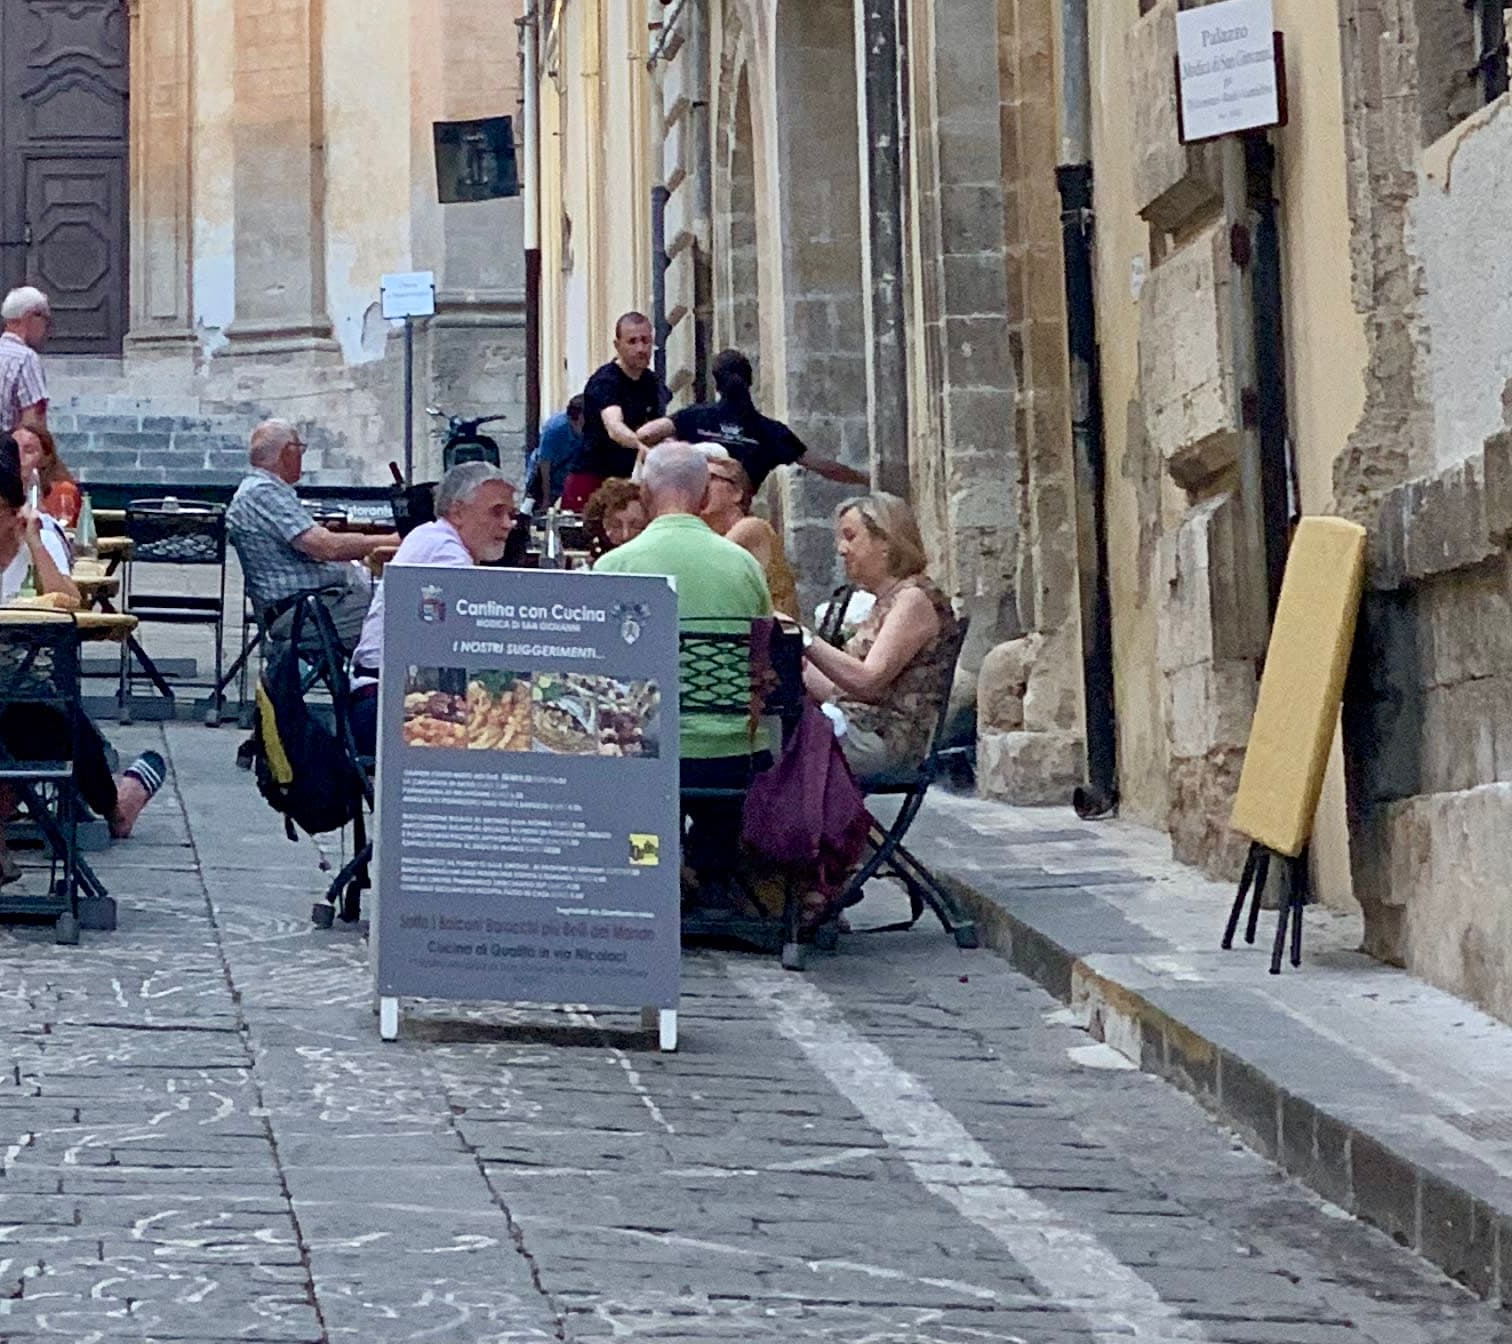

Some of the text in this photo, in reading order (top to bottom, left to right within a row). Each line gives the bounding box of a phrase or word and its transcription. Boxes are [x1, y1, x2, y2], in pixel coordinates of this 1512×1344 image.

[1200, 25, 1249, 48] Palazzo
[455, 598, 606, 622] Cantina con Cucina
[460, 641, 504, 654] NOSTRI
